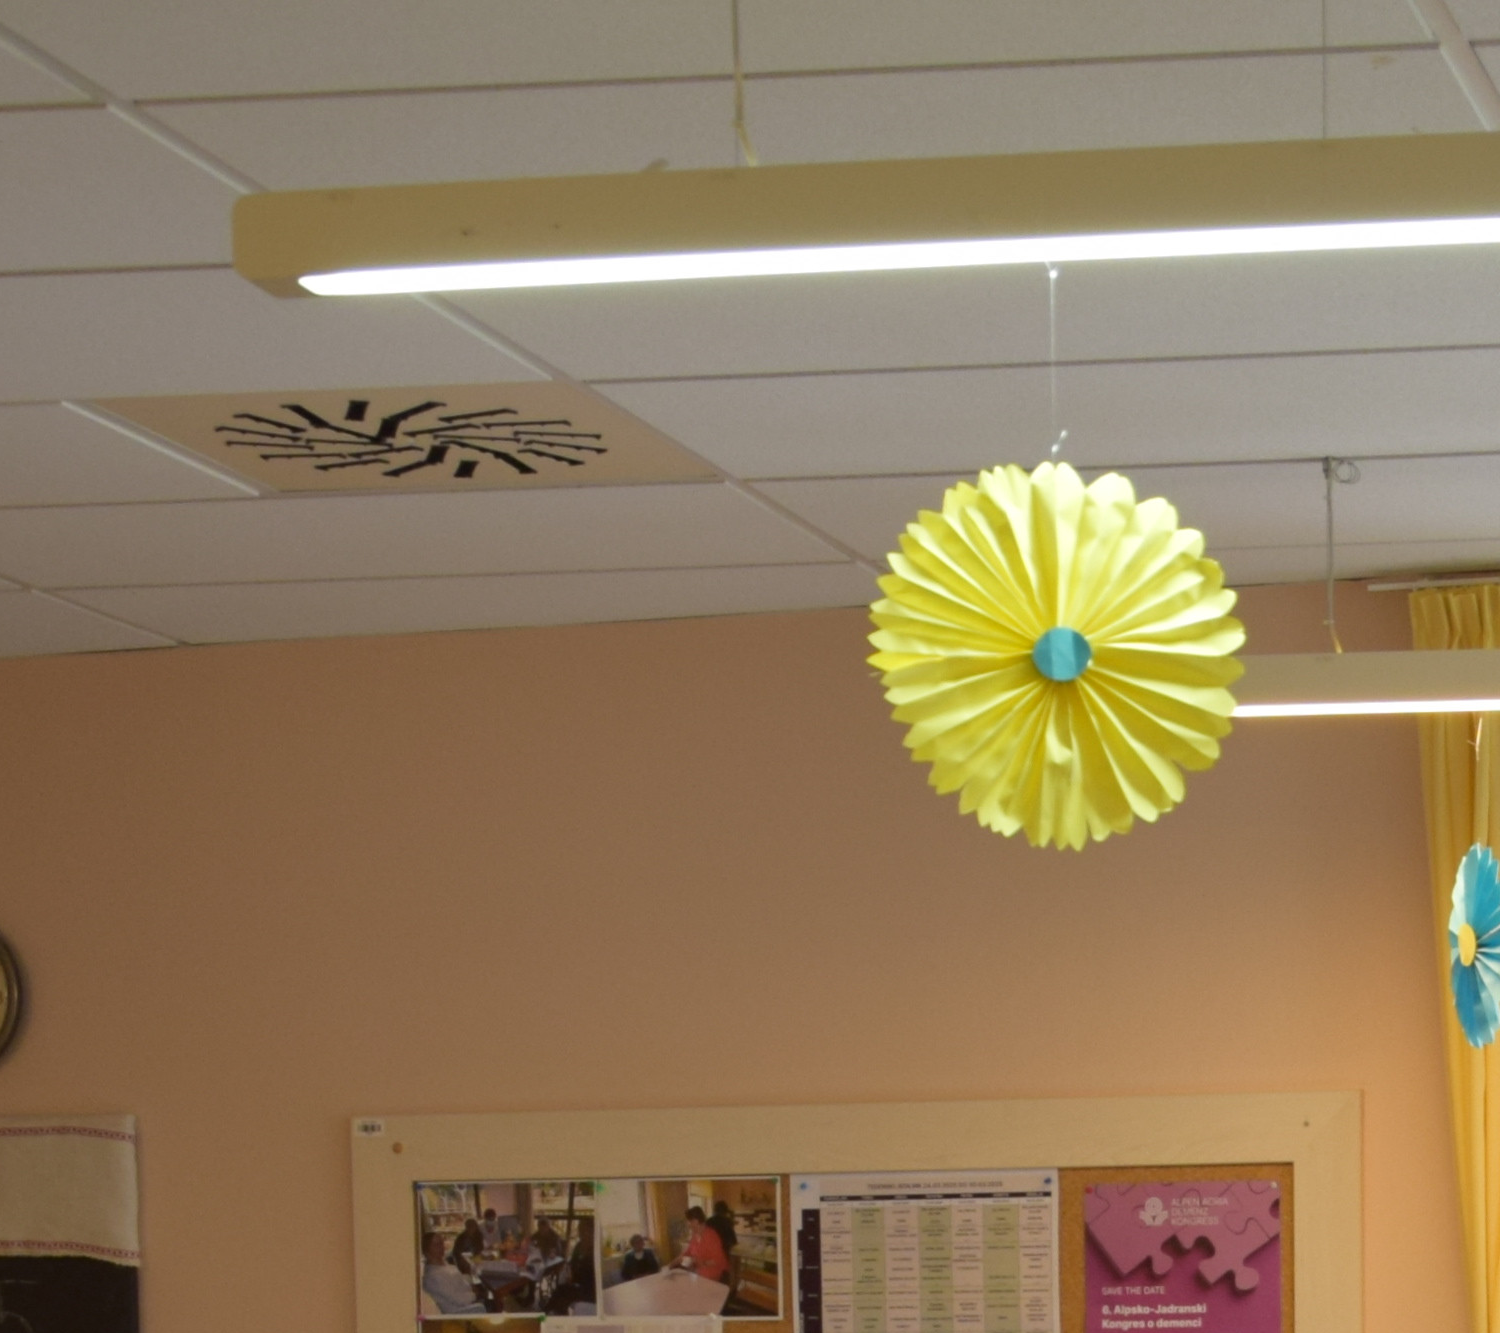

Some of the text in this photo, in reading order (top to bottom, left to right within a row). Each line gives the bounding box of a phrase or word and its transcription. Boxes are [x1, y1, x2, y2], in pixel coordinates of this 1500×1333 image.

[1102, 1286, 1165, 1296] SAVE THE DATE
[1114, 1303, 1207, 1317] Alpsko-Jadranski
[1102, 1317, 1202, 1331] Kongres o demenci
